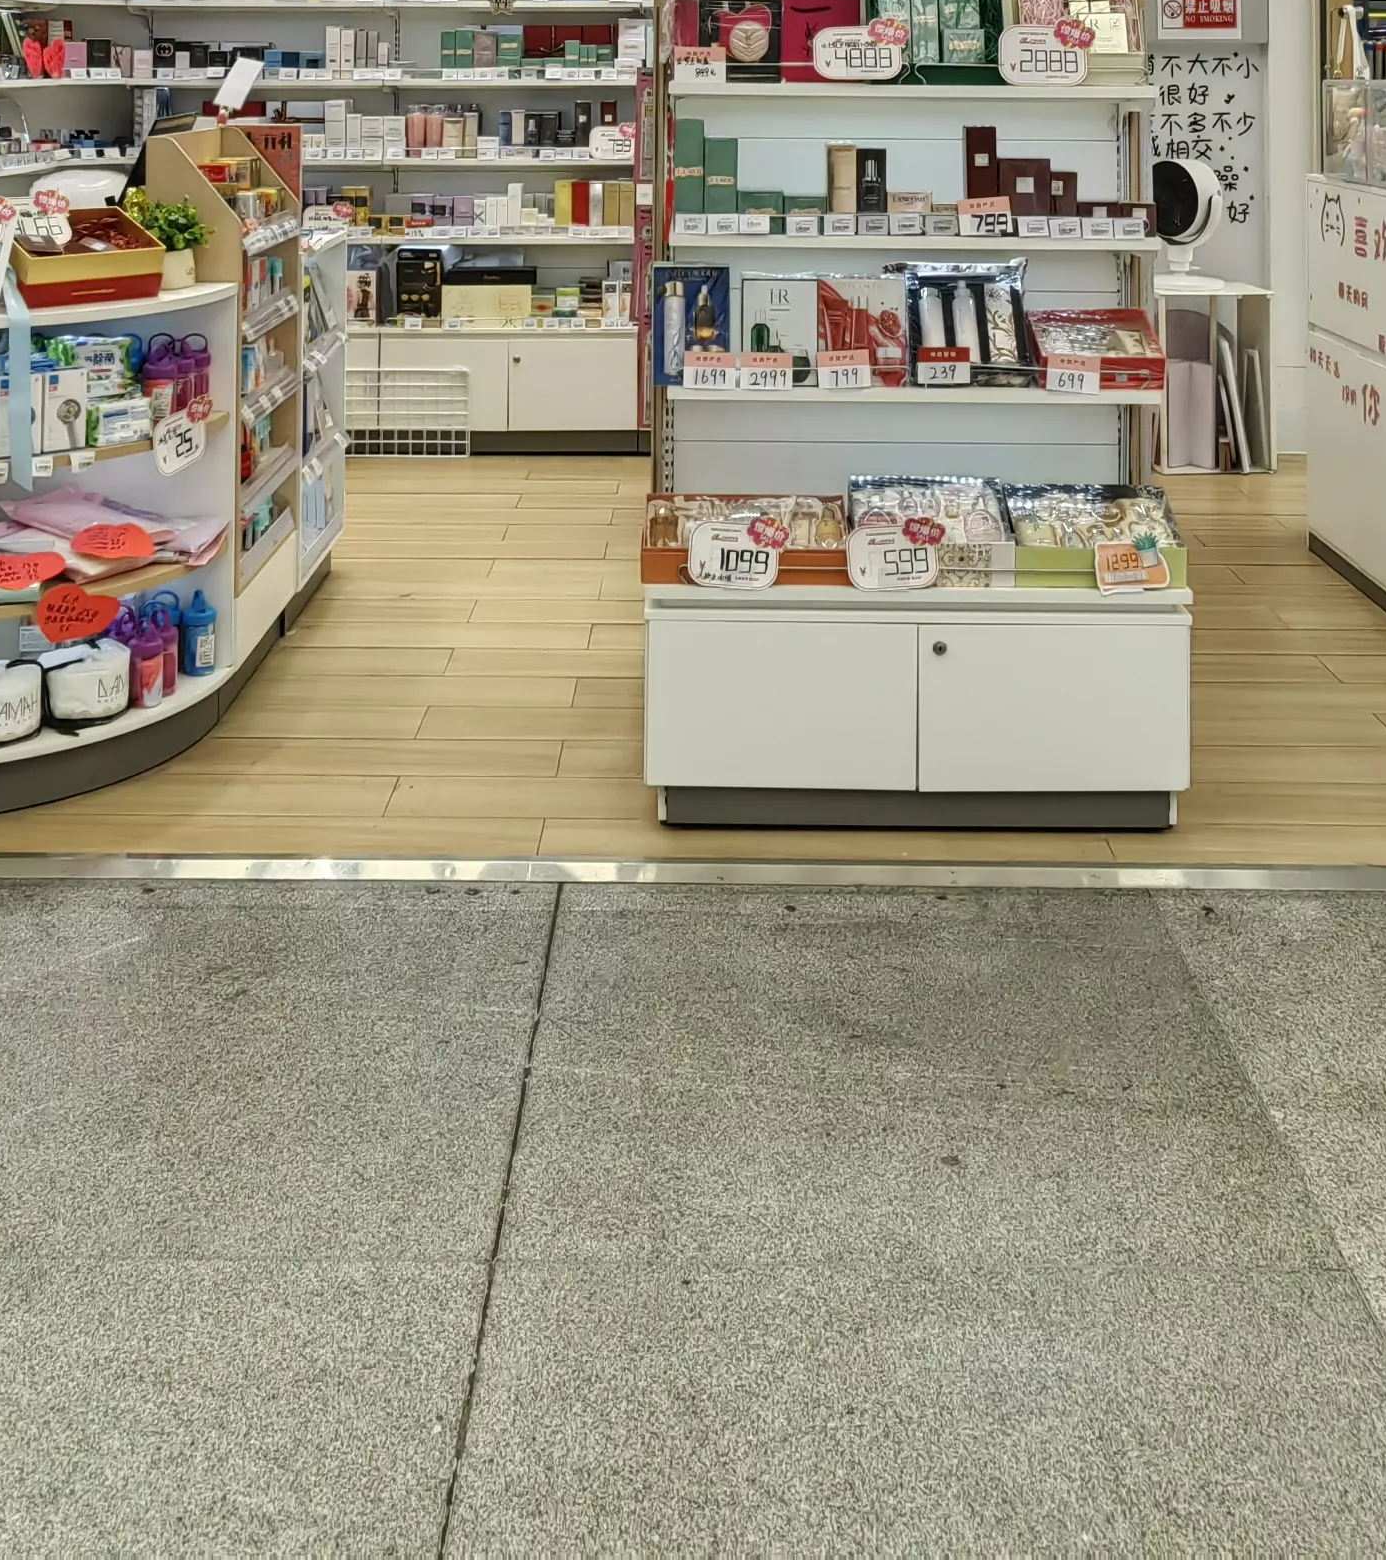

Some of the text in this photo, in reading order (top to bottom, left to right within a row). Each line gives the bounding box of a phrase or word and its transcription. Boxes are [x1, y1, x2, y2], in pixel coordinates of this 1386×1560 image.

[1200, 15, 1234, 23] SMOKING
[835, 47, 893, 69] 4888
[1019, 48, 1079, 73] 2888
[1151, 111, 1256, 137] 不多不少
[971, 212, 1009, 234] 799
[693, 369, 727, 385] 1699
[749, 370, 787, 386] 2999
[830, 367, 859, 388] 799
[928, 365, 957, 380] 239
[1057, 372, 1085, 390] 699
[175, 427, 193, 458] 25
[720, 547, 770, 575] 1099
[883, 547, 930, 576] 599
[1106, 552, 1141, 571] 1299
